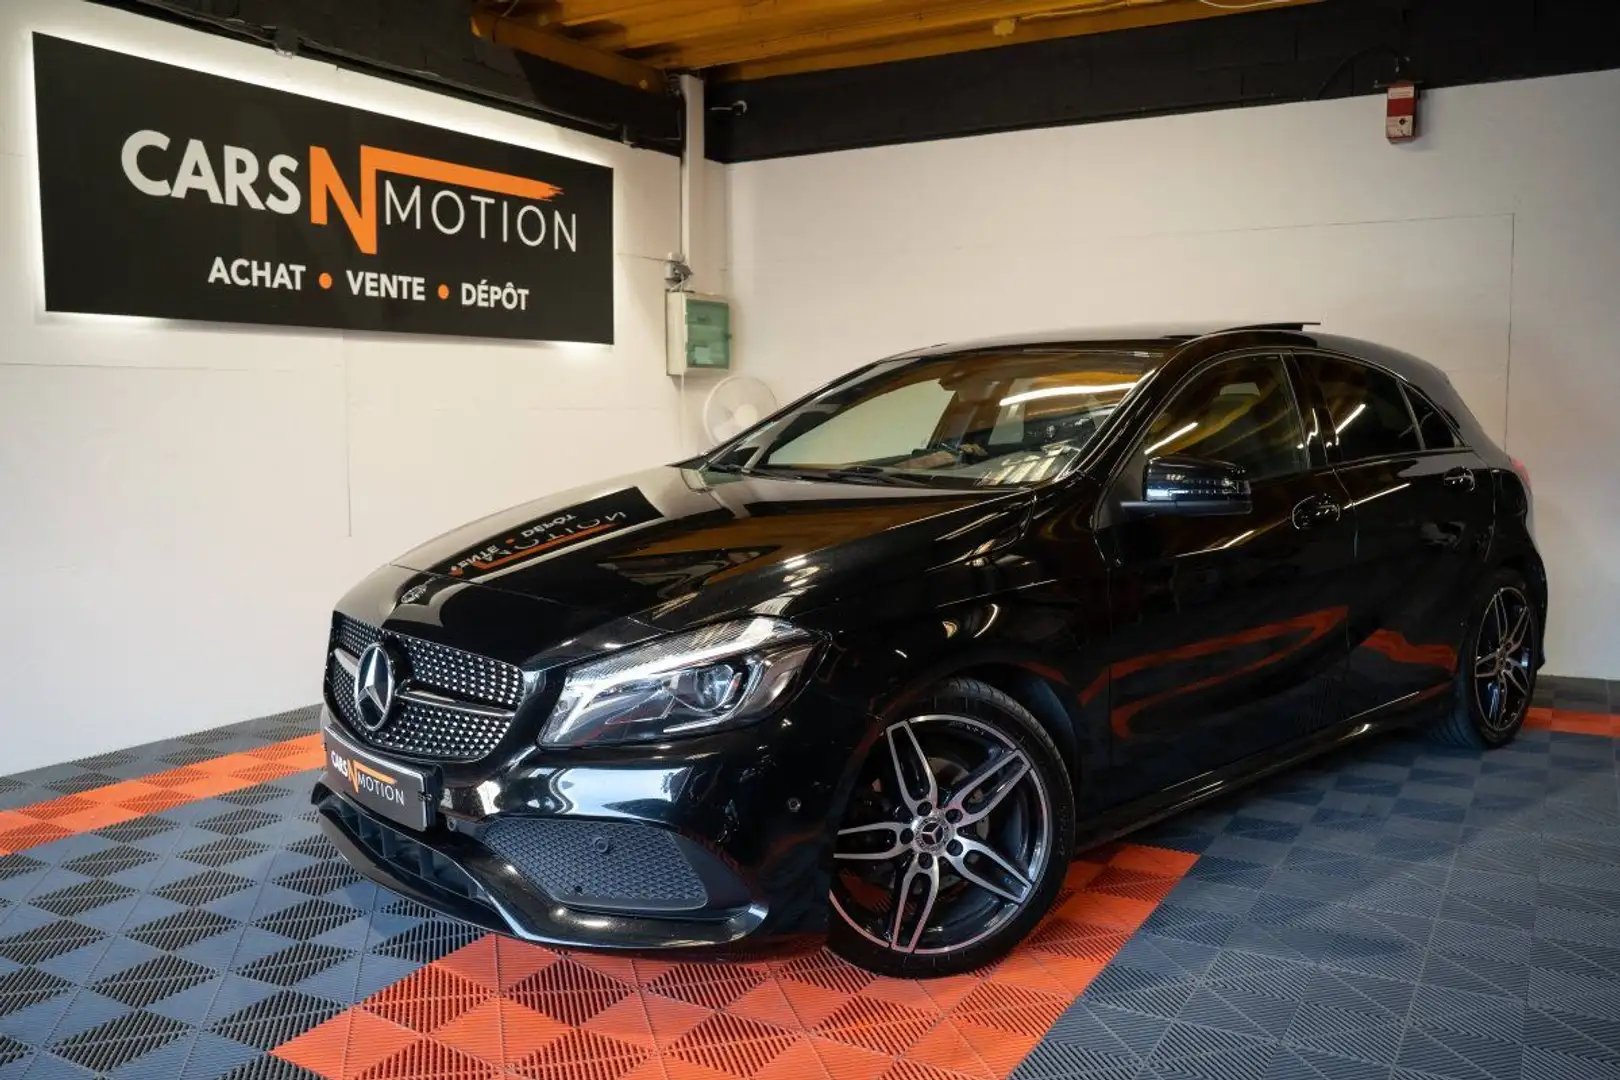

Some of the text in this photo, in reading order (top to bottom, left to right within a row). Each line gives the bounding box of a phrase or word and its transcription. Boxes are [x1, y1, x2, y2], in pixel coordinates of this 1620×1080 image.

[121, 129, 301, 214] CARS
[385, 179, 577, 252] MOTION
[207, 256, 530, 311] ACHAT VENTE DÉPÔT
[358, 771, 405, 806] MOTION
